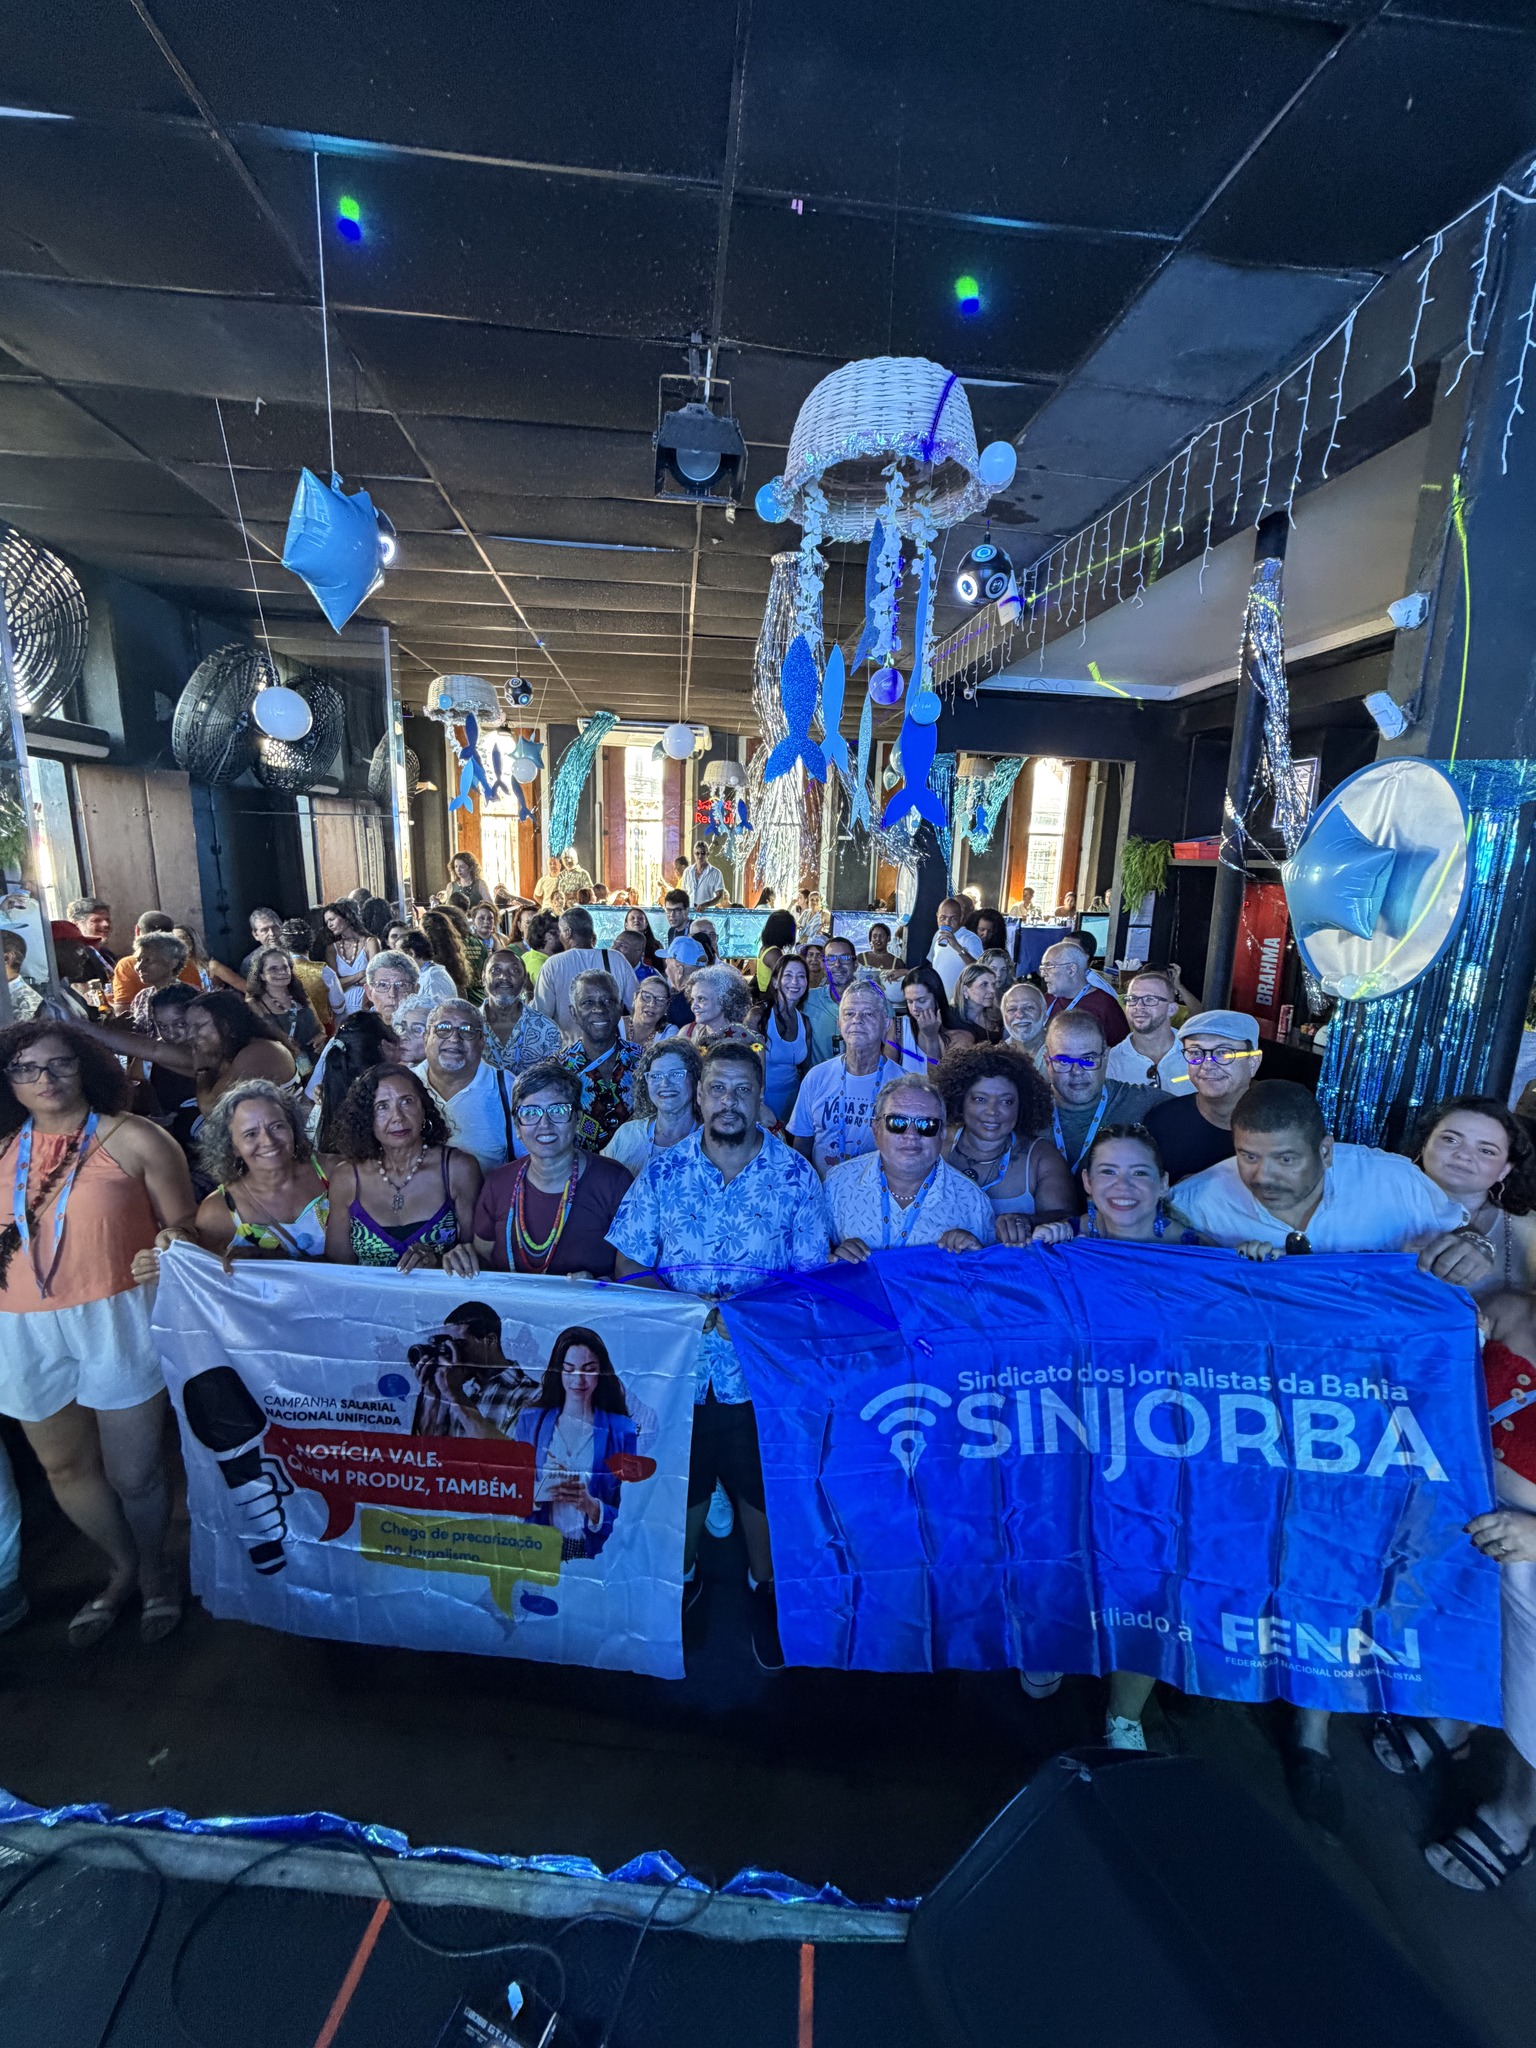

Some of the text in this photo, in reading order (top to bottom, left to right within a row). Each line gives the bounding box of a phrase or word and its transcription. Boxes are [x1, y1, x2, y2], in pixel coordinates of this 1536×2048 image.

[694, 812, 711, 824] Re
[1256, 937, 1281, 1006] BRAHMA
[821, 1096, 855, 1130] NAA
[958, 1362, 1409, 1401] Sindicato dos Jornalistas da Bahia
[263, 1395, 396, 1413] CAMPANHA SALARIAL
[265, 1407, 401, 1426] NACIONAL UNIFICADA
[956, 1386, 1450, 1483] SINJORBA
[296, 1440, 384, 1463] NOTÍCIA
[389, 1448, 443, 1468] VALE.
[287, 1454, 523, 1499] QUEM PRODUZ, TAMBÉM.
[381, 1521, 543, 1551] Chega de precarização
[1221, 1612, 1420, 1669] FENAJ
[1281, 1660, 1331, 1678] NACIONAL
[1333, 1669, 1354, 1678] DOS
